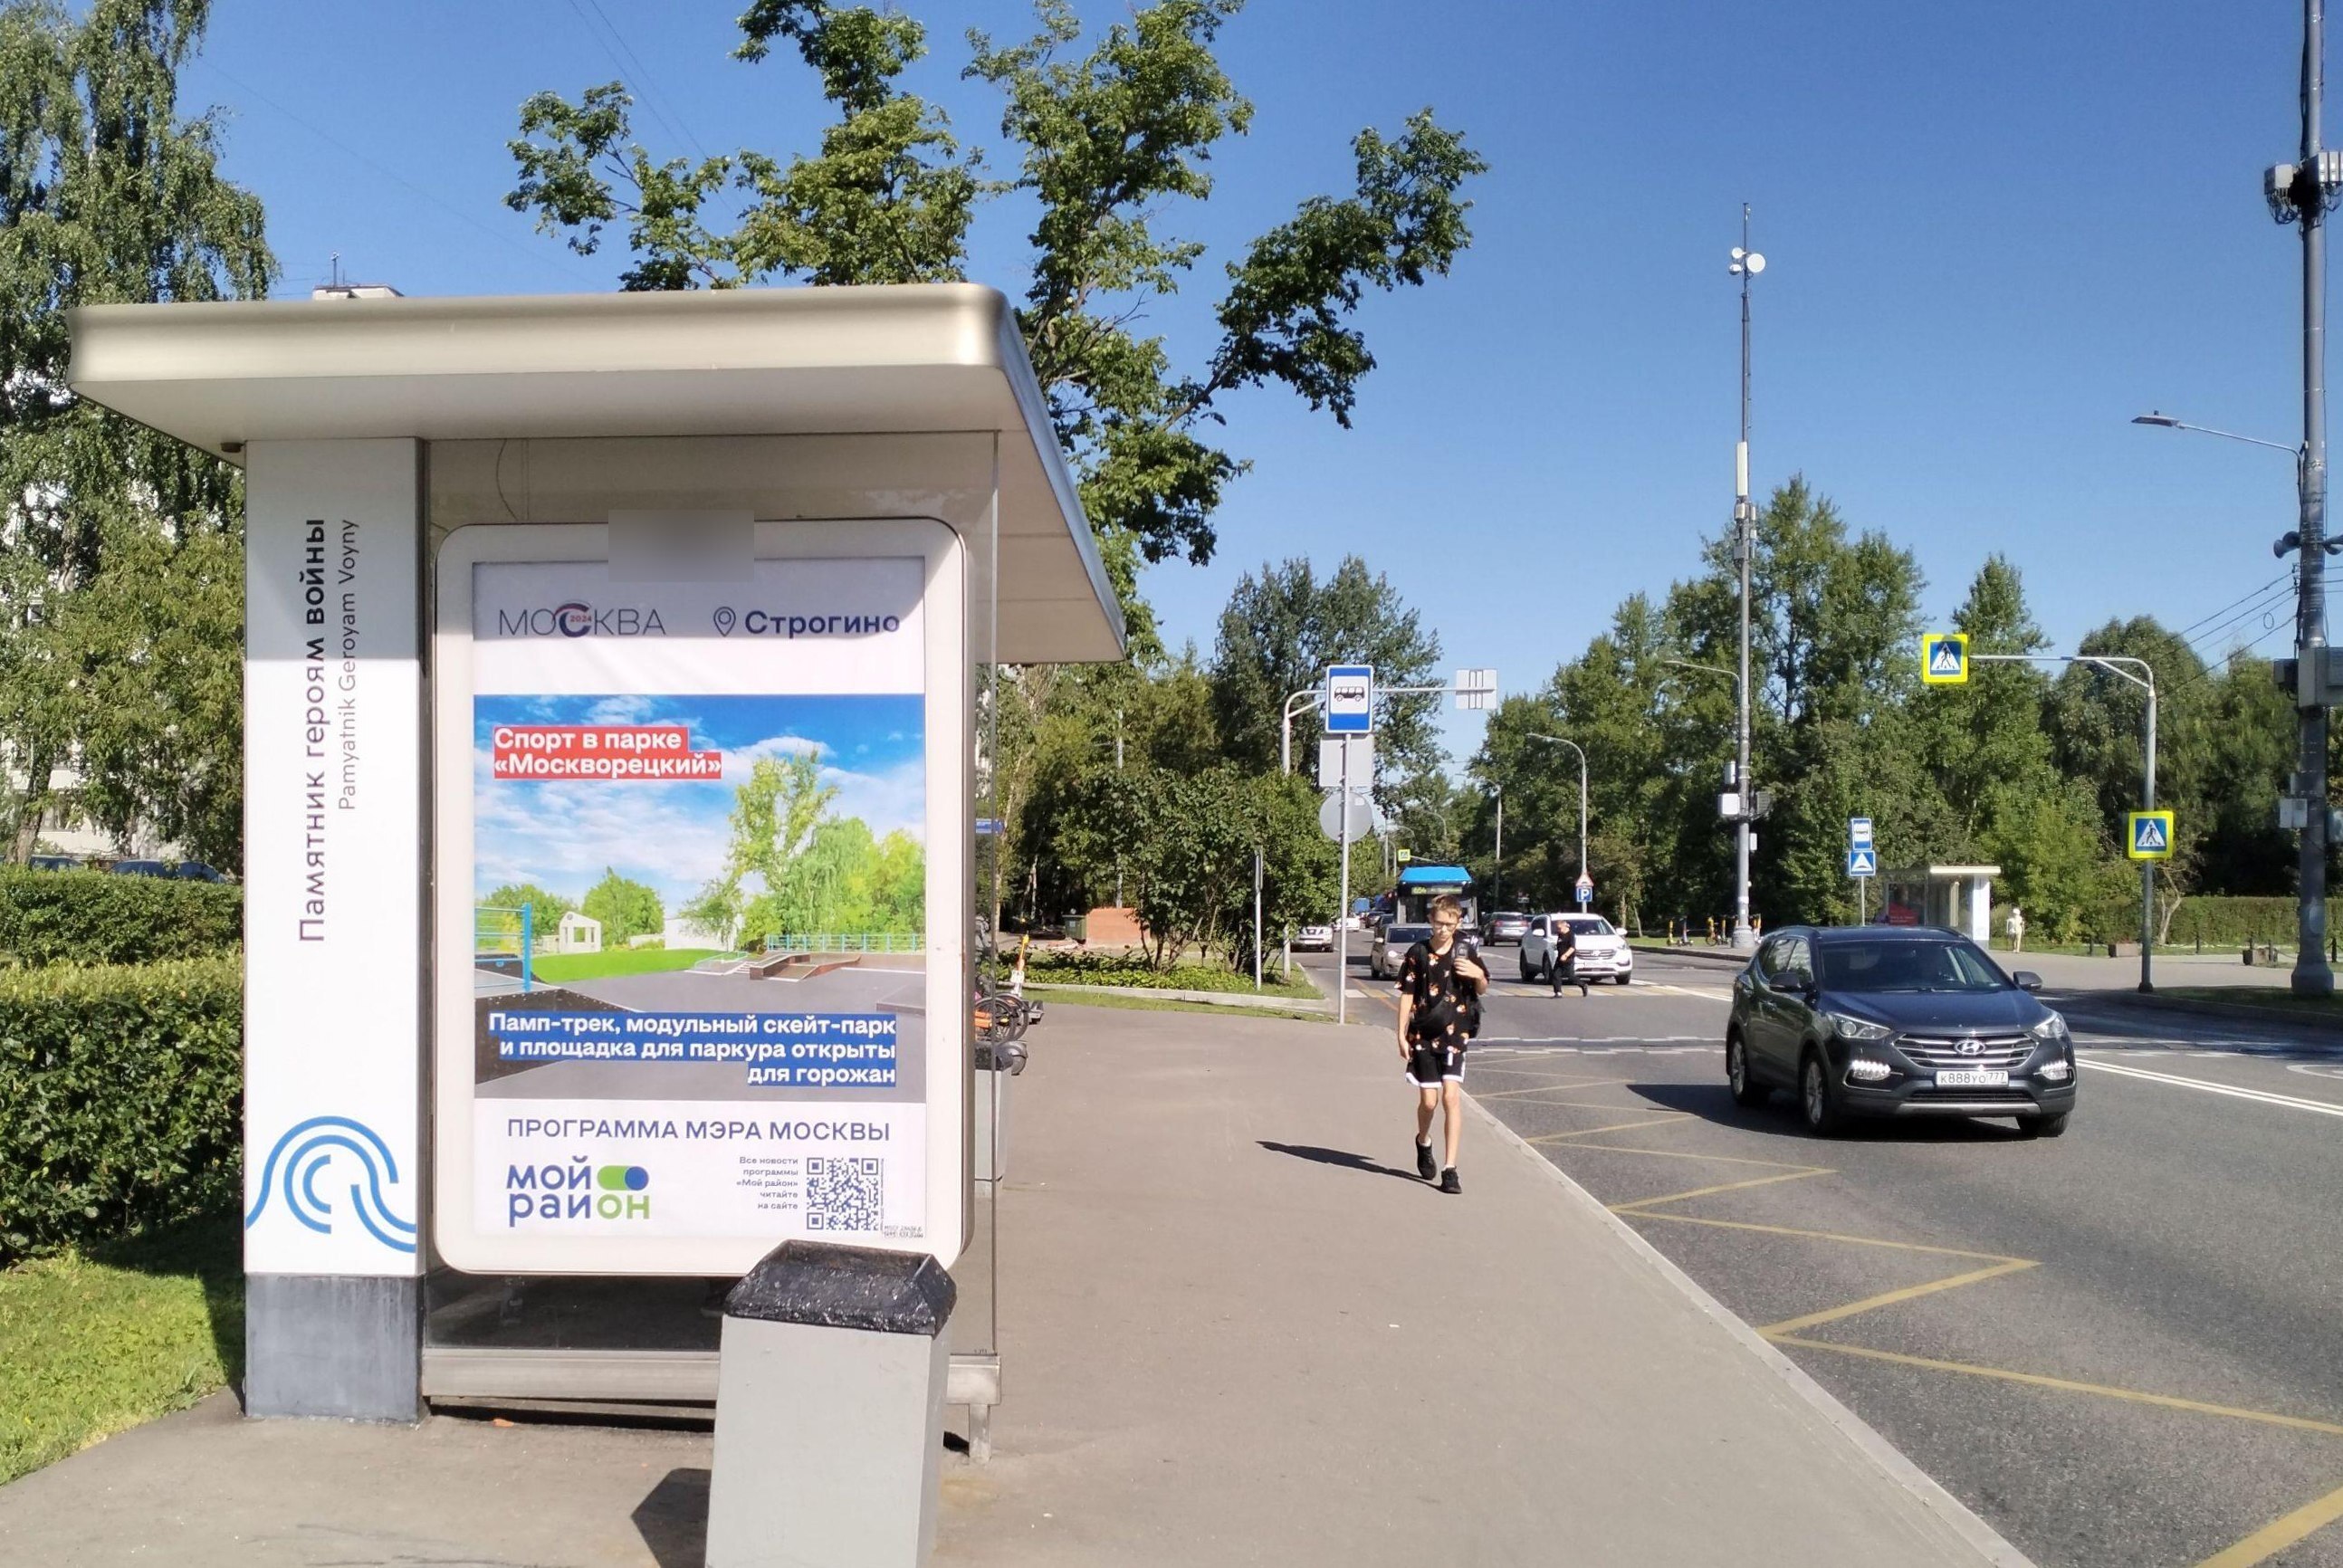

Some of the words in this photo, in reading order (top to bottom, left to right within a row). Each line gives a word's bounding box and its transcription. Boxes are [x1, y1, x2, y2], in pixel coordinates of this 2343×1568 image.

[338, 519, 359, 586] Voyny
[299, 519, 325, 625] войны
[500, 602, 666, 637] МОСКВА
[569, 615, 592, 623] 2024
[745, 609, 900, 639] Строгино
[338, 593, 359, 692] Geroyam
[306, 637, 330, 758] героям
[494, 728, 576, 754] Спорт
[582, 732, 598, 749] в
[605, 732, 682, 754] парке
[338, 700, 359, 810] Pamyatnik
[494, 752, 722, 779] «Москворецкий»
[299, 770, 325, 942] Памятник
[489, 1013, 621, 1036] Памп-трек,
[626, 1015, 759, 1037] модульный
[763, 1015, 896, 1038] скейт-парк
[500, 1041, 513, 1056] и
[520, 1041, 636, 1058] площадка
[641, 1042, 684, 1058] для
[689, 1043, 786, 1062] паркура
[791, 1044, 895, 1062] открыты
[747, 1067, 789, 1084] для
[796, 1067, 895, 1086] горожан
[507, 1118, 679, 1140] ПРОГРАММА
[685, 1120, 762, 1141] МЭРА
[770, 1122, 890, 1142] МОСКВЫ
[506, 1155, 591, 1190] мой
[739, 1156, 758, 1164] Все
[743, 1169, 799, 1177] программы
[760, 1190, 799, 1199] читайте
